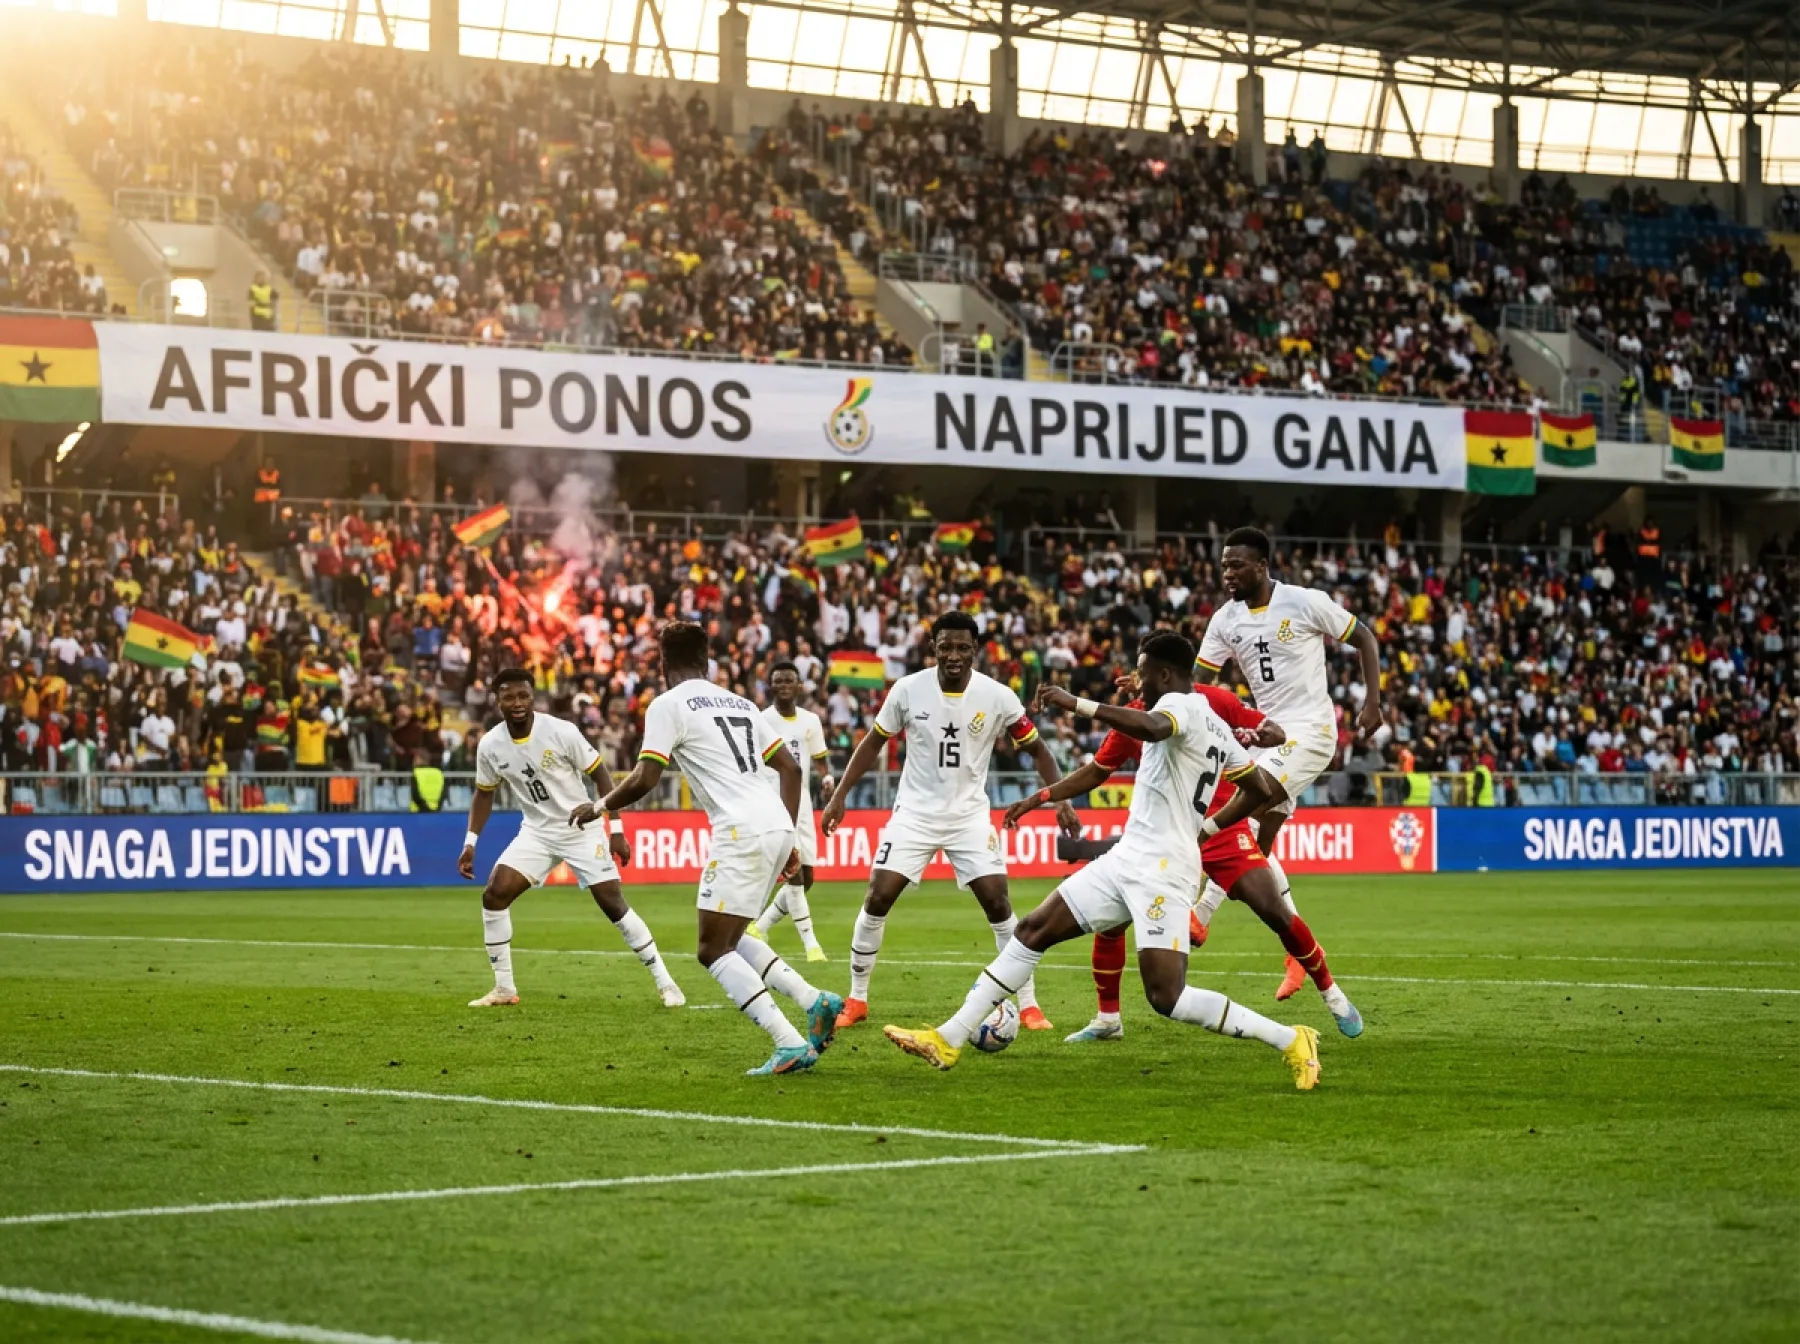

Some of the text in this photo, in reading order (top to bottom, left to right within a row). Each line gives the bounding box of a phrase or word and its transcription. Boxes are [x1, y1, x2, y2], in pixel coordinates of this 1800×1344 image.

[148, 343, 1439, 475] AFRIČKI PONOS NAPRIJED GANA
[1259, 656, 1275, 682] 6
[713, 716, 758, 774] 17
[938, 741, 960, 768] 15
[524, 779, 550, 804] 10
[24, 827, 411, 880] SNAGA JEDINSTVA
[1523, 817, 1784, 860] SNAGA JEDINSTVA
